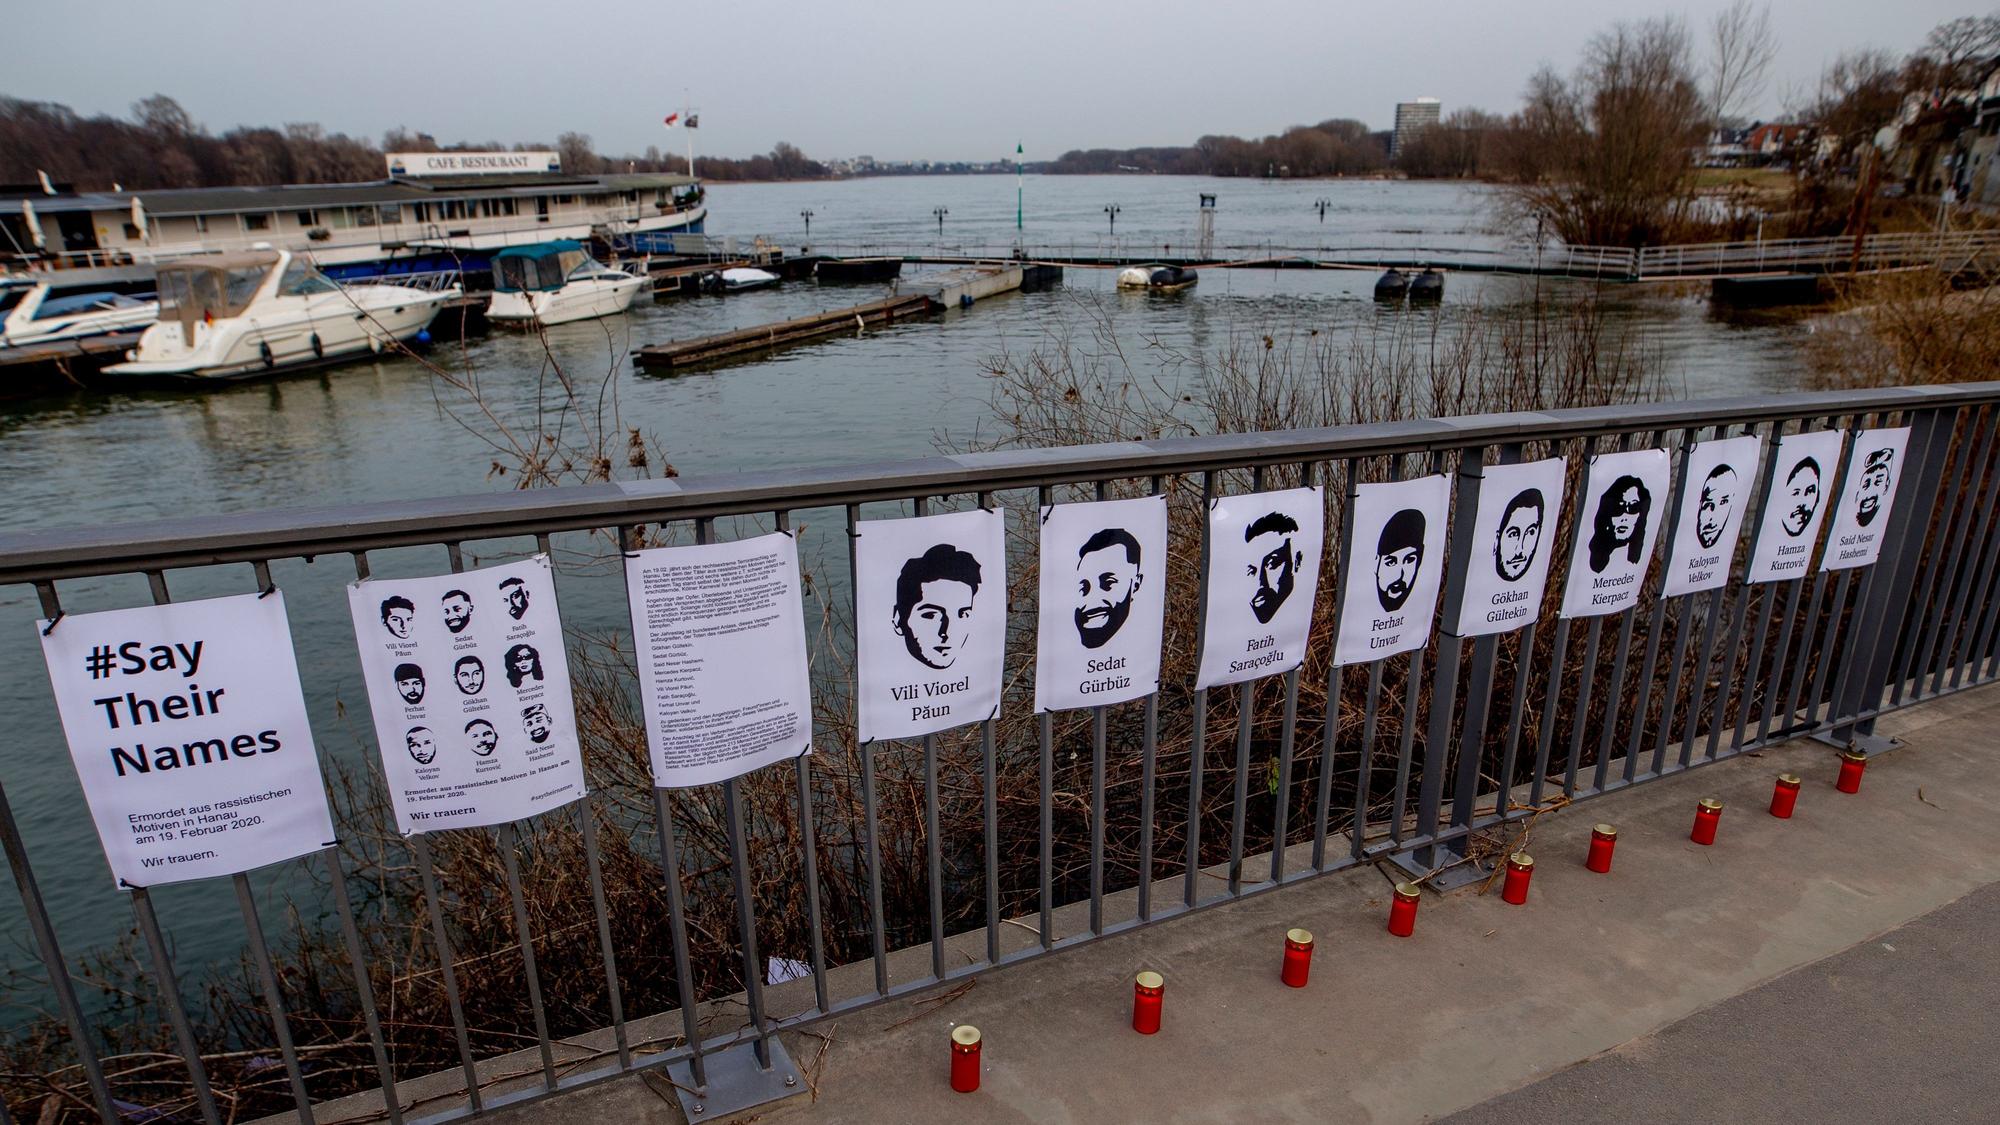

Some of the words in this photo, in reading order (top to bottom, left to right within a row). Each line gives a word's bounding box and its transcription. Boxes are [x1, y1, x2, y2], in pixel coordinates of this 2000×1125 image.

[461, 156, 528, 168] RESTAURANT
[1778, 544, 1805, 556] Hamza
[1839, 547, 1868, 560] Hashemi
[1688, 554, 1720, 569] Kaloyan
[1770, 557, 1805, 571] Kurtović
[1593, 574, 1634, 589] Mercedes
[1688, 571, 1713, 584] Velkov
[1492, 590, 1528, 605] Gökhan
[1592, 591, 1629, 606] Kierpacz
[1486, 606, 1527, 622] Gültekin
[1372, 616, 1404, 632] Ferhat
[453, 642, 477, 650] Gürbüz
[1246, 636, 1274, 651] Fatih
[1370, 635, 1400, 649] Unvar
[86, 640, 203, 679] #Say
[1087, 656, 1126, 673] Sedat
[1229, 650, 1284, 673] Saraçoğlu
[516, 685, 544, 696] Mercedes
[891, 686, 918, 701] Vili
[924, 677, 969, 697] Viorel
[1079, 676, 1130, 694] Gürbüz
[94, 684, 224, 728] Their
[463, 697, 488, 706] Gökhan
[912, 704, 950, 721] Păun
[111, 730, 281, 776] Names
[476, 758, 498, 766] Hamza
[414, 766, 440, 775] Kaloyan
[404, 787, 437, 797] Ermordet
[454, 779, 498, 790] rassistischen
[501, 772, 528, 783] Motiven
[538, 763, 559, 773] Hanau
[419, 792, 445, 801] Februar
[128, 807, 186, 823] Ermordet
[189, 802, 212, 814] aus
[214, 787, 292, 810] rassistischen
[410, 811, 430, 821] Wir
[434, 806, 476, 818] trauern
[132, 818, 180, 834] Motiven
[184, 816, 195, 827] in
[198, 810, 238, 824] Hanau
[136, 835, 155, 844] am
[159, 830, 177, 841] 19.
[181, 823, 228, 839] Februar
[231, 816, 265, 829] 2020.
[142, 856, 166, 868] Wir
[168, 850, 218, 864] trauern.
